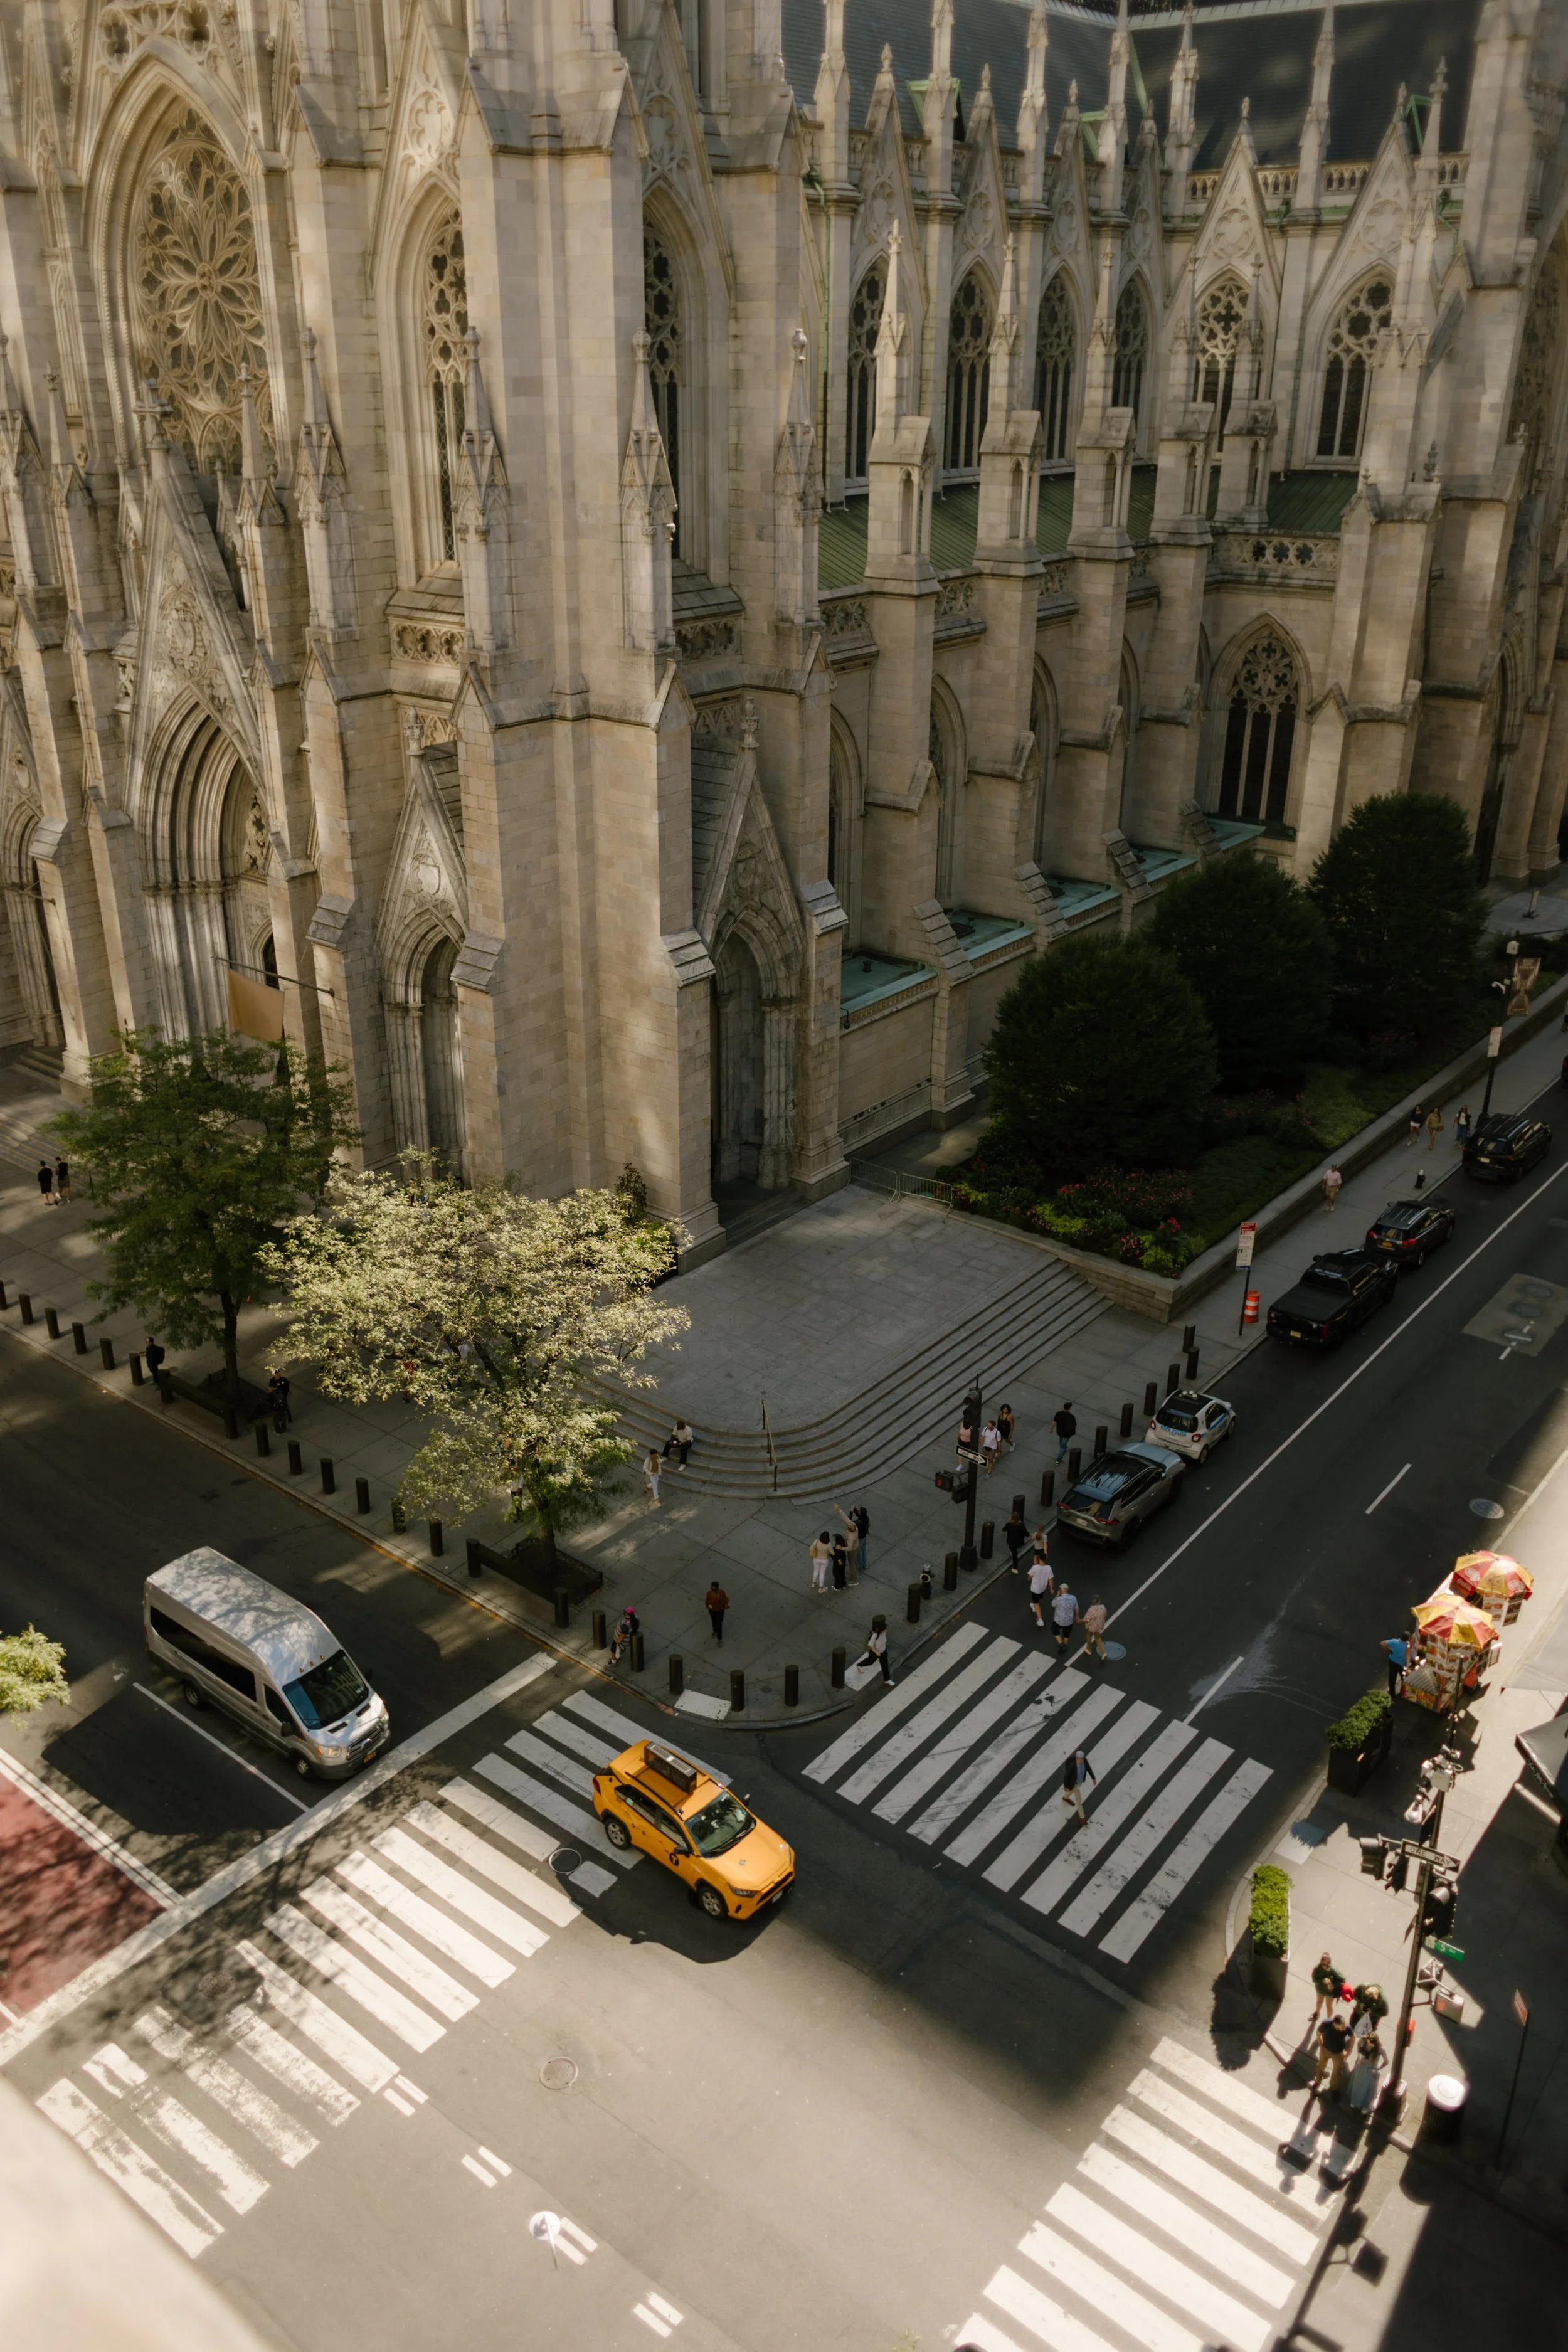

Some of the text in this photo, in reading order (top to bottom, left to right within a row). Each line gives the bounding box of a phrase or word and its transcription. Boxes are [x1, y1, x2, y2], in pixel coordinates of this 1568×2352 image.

[1410, 1846, 1451, 1866] ONE WAY
[1439, 1944, 1446, 1952] 5
